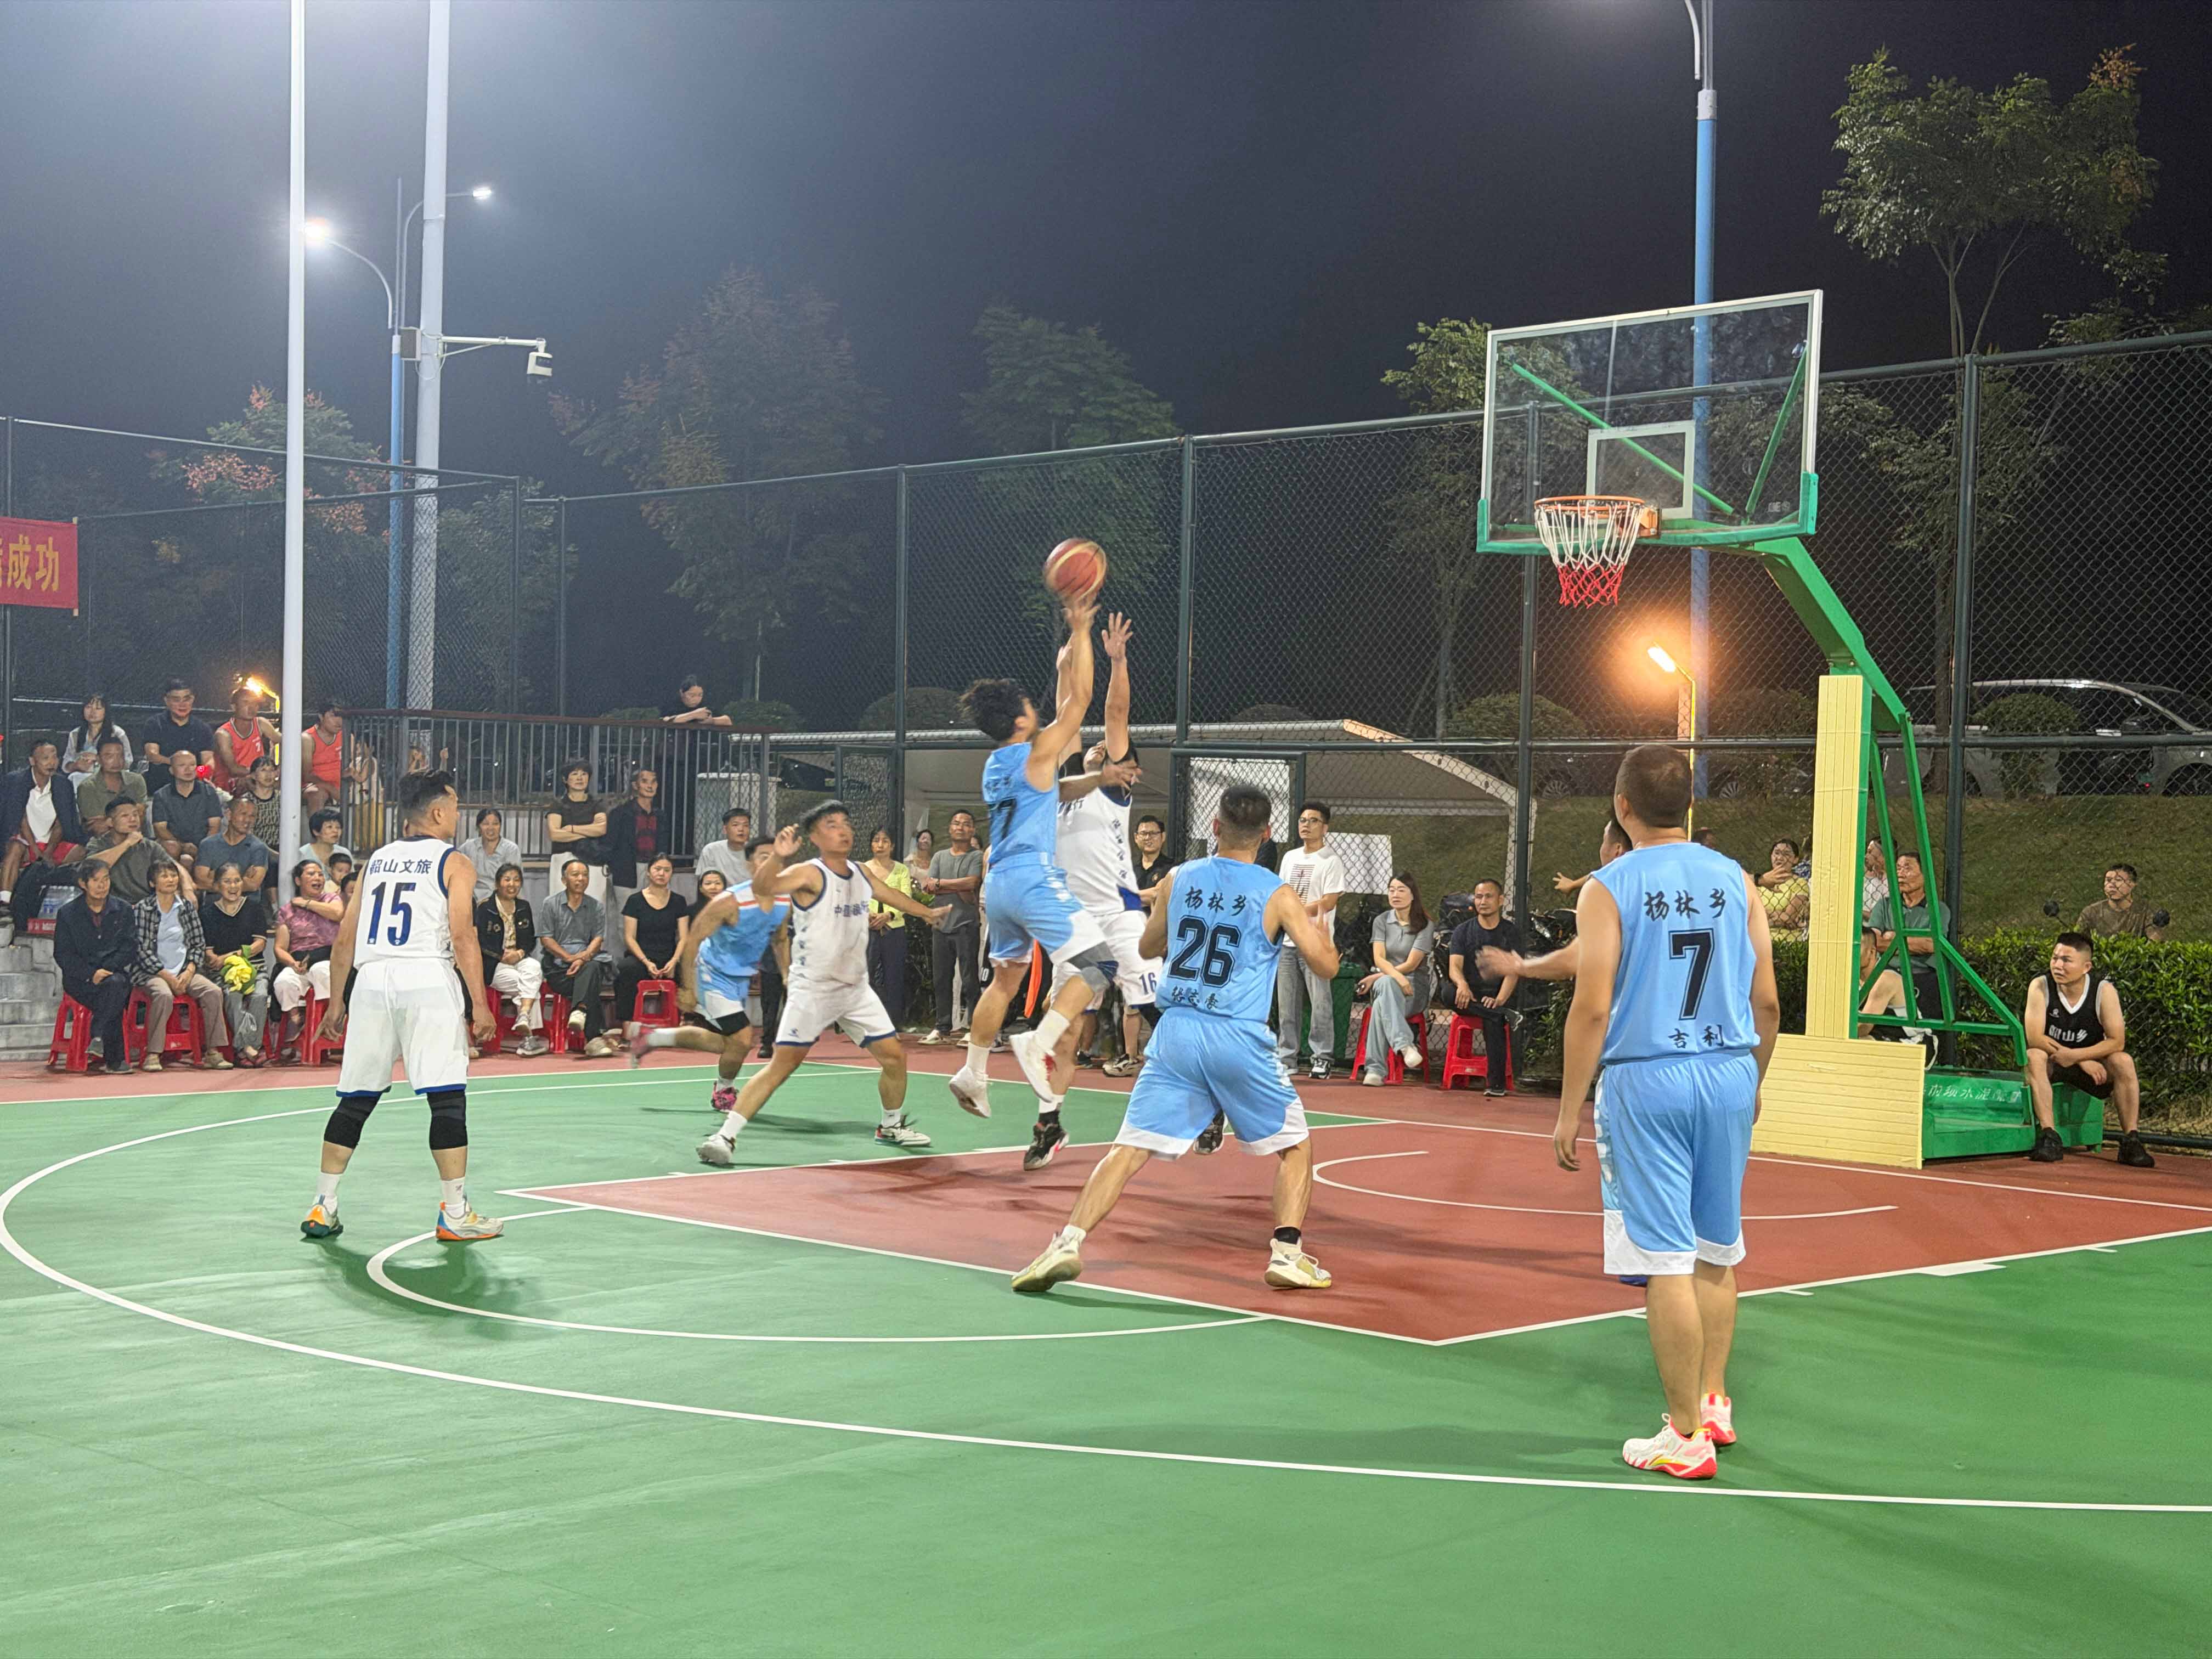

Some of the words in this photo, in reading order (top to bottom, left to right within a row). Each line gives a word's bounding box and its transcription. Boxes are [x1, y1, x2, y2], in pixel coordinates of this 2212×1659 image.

[0, 534, 59, 592] 成功
[370, 859, 433, 874] 韶山文旅
[367, 881, 416, 946] 15
[1185, 887, 1246, 916] 杨林乡
[1644, 888, 1726, 921] 杨林乡
[1167, 915, 1242, 988] 26
[1139, 972, 1156, 995] 16
[1668, 928, 1715, 1020] 7
[1668, 1024, 1724, 1048] 吉利
